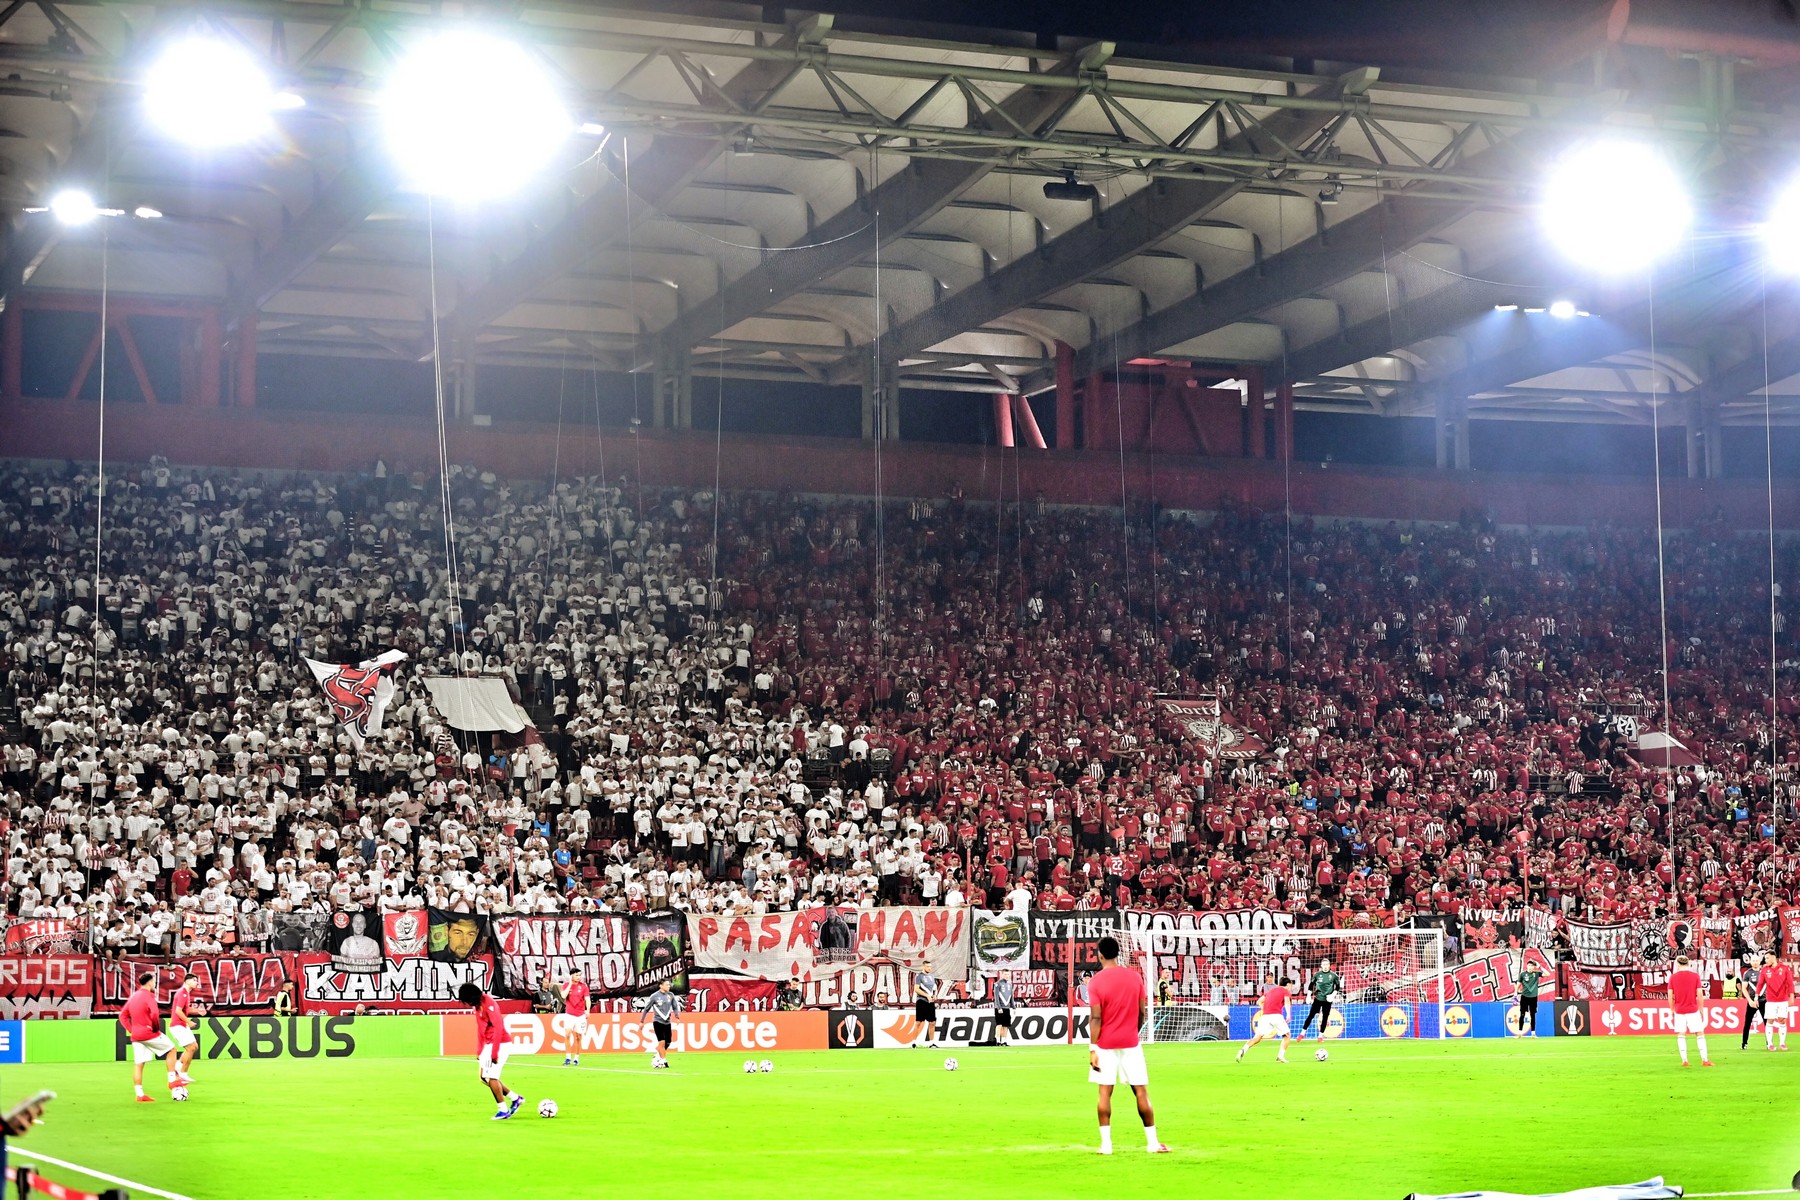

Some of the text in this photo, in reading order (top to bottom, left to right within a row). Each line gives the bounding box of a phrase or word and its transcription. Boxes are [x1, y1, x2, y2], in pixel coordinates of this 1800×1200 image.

[1034, 917, 1115, 938] ΔΥΤΙΚΗ
[1465, 908, 1520, 922] ΚΥΨΕΛΗ
[698, 910, 964, 953] PASA MANI
[1127, 910, 1294, 956] ΚΟΛΩΝΟΣ
[1569, 923, 1631, 949] MISFIT
[637, 957, 683, 988] ΑΘΑΝΑΤΟΣ
[998, 969, 1054, 983] ΕΝΙΔΙ
[551, 1014, 778, 1052] Swissquote
